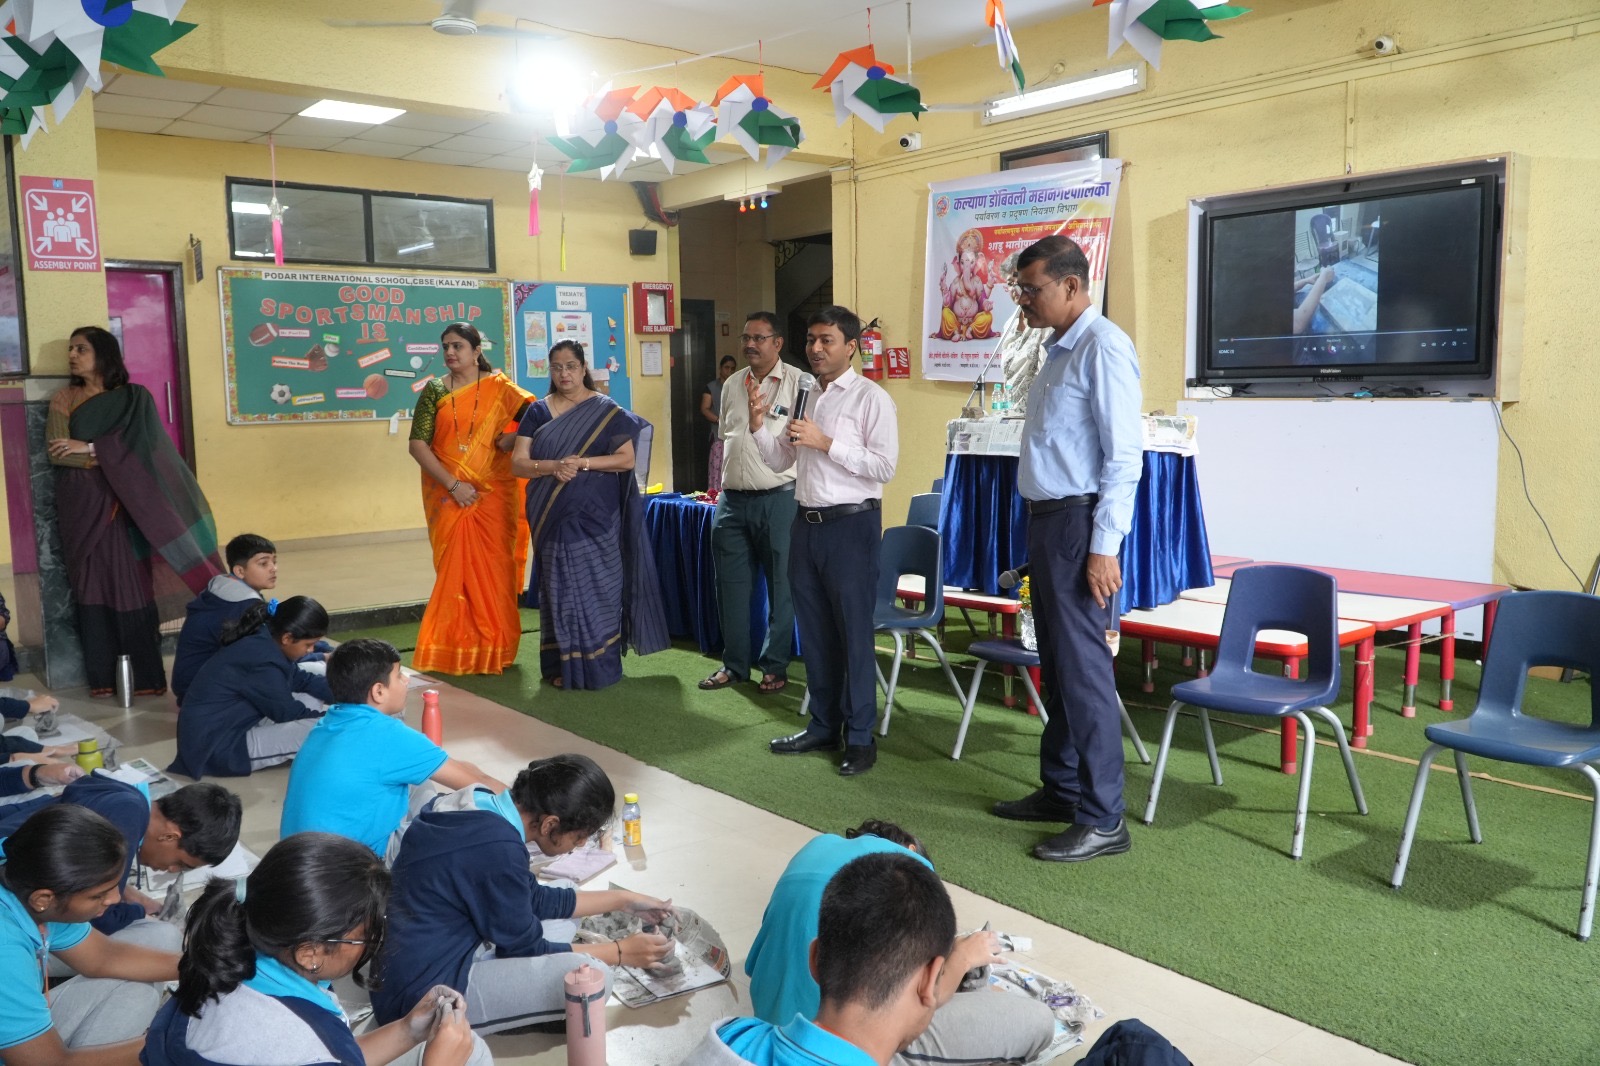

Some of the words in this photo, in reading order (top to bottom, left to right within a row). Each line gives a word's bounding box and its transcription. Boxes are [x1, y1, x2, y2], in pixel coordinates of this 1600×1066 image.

[953, 195, 987, 210] कल्याण
[975, 210, 1000, 221] पर्यावरण
[1009, 209, 1028, 222] प्रदूषण
[1057, 203, 1078, 214] विभाग
[34, 260, 72, 269] ASSEMBLY
[73, 261, 97, 270] POINT
[264, 272, 297, 280] PODAR
[299, 273, 373, 283] INTERNATIONAL
[338, 285, 405, 305] GOOD
[260, 298, 482, 326] SPORTSMANSHIP
[361, 322, 386, 340] IS
[643, 325, 653, 333] FIRE
[654, 325, 674, 333] BLANKET
